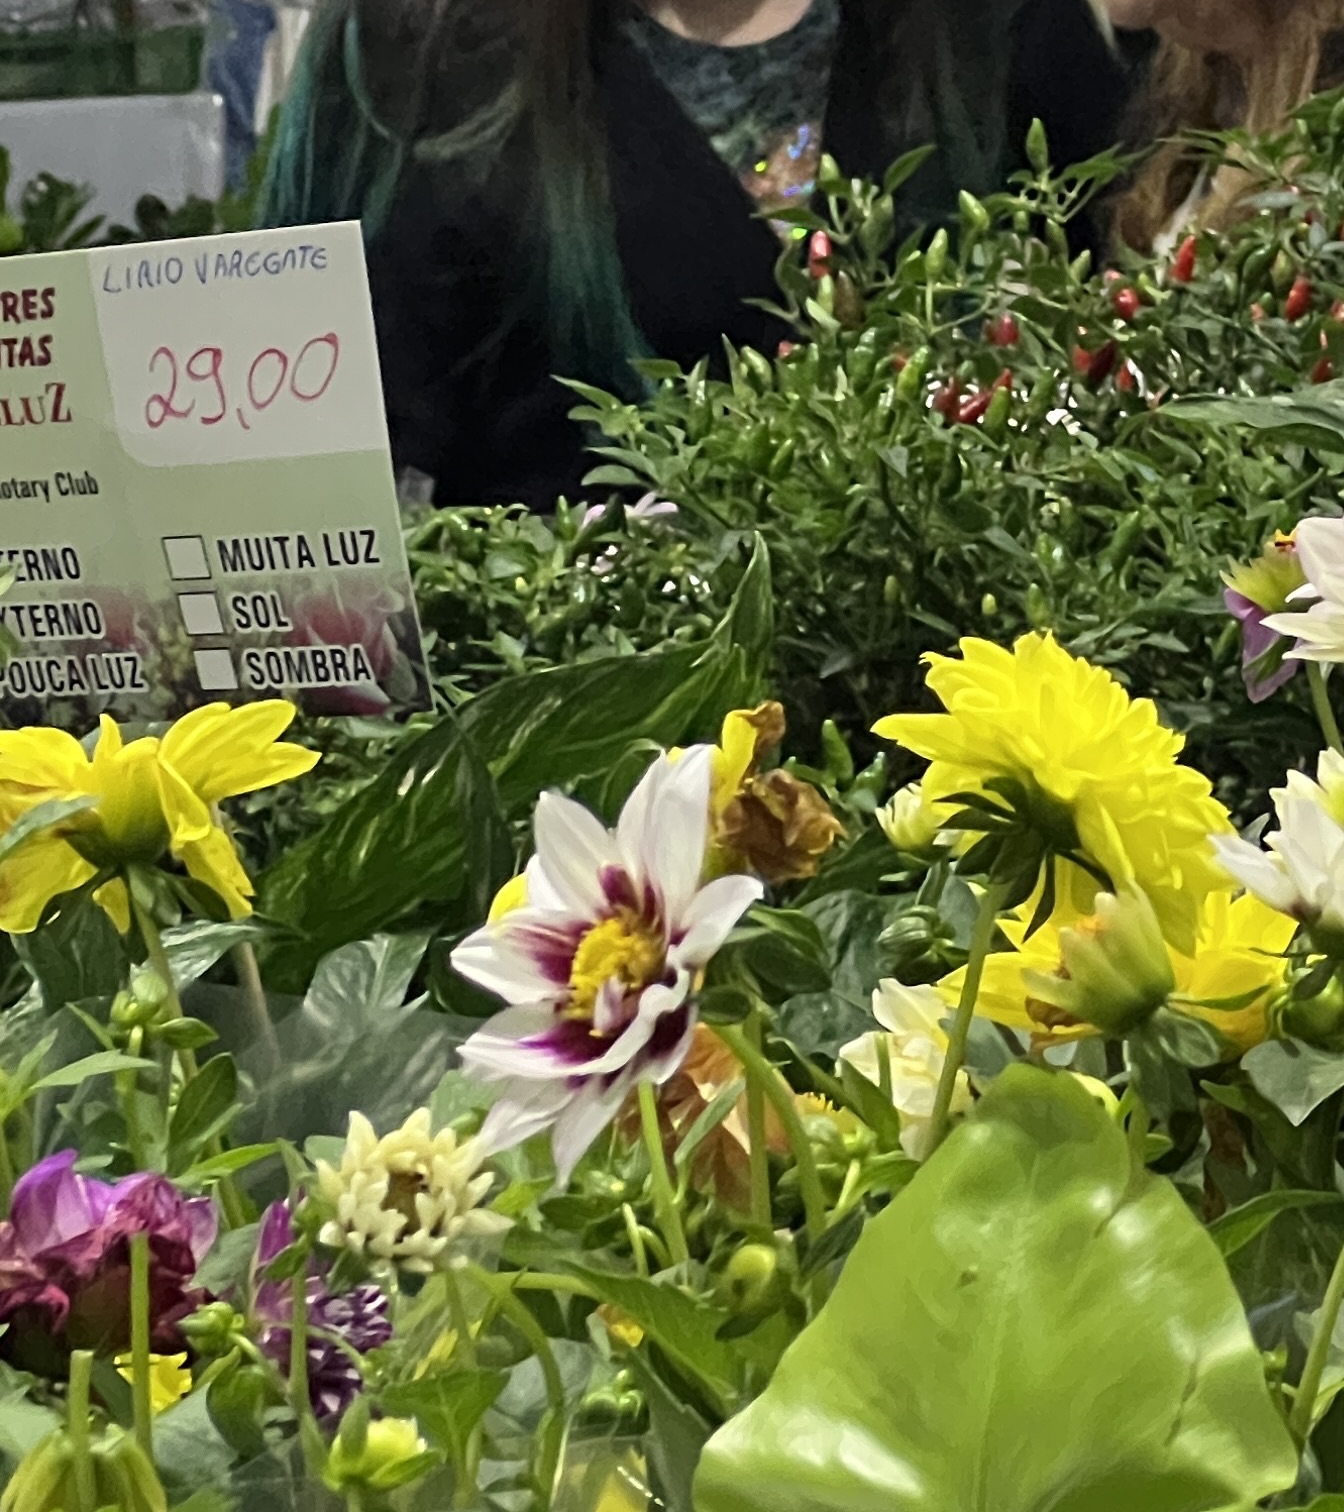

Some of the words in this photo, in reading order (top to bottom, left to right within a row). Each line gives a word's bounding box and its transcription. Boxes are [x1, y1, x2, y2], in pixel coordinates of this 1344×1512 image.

[102, 257, 184, 293] LIRIO
[145, 332, 339, 430] 29,00
[0, 477, 51, 503] otary
[57, 469, 99, 496] Club
[217, 535, 315, 573] MUITA
[323, 529, 380, 566] LUZ
[232, 593, 290, 629] SOL
[90, 657, 143, 689] LUZ
[246, 648, 371, 685] SOMBRA
